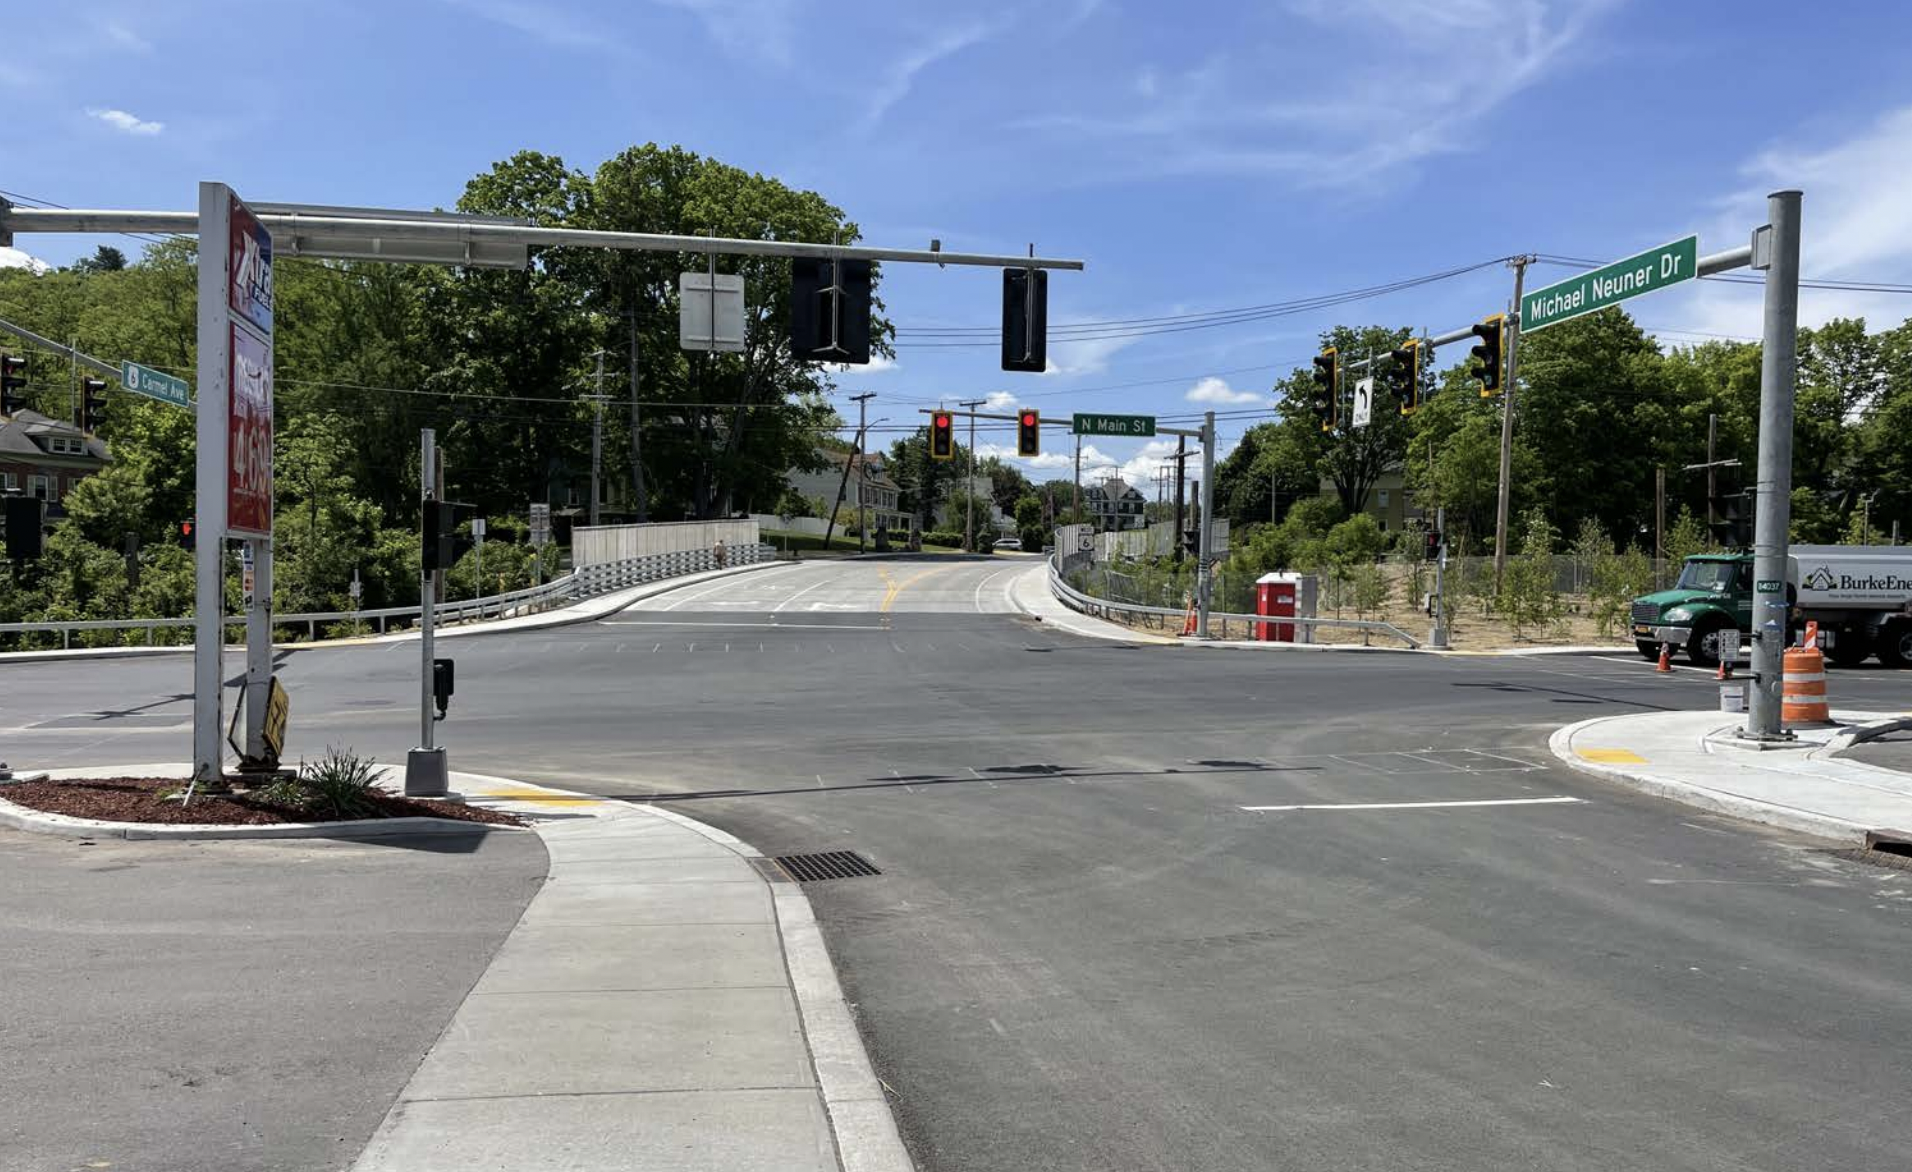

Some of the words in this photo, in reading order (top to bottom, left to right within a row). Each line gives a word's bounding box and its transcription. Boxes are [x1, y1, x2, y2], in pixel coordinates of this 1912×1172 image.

[1531, 283, 1585, 321] Michael
[1592, 265, 1653, 302] Neuner
[1660, 253, 1682, 279] Dr
[142, 373, 167, 396] Carmel
[171, 383, 185, 400] Ave
[1082, 418, 1091, 431] N
[1097, 418, 1127, 432] Main
[1133, 420, 1146, 433] St
[1082, 537, 1090, 548] 6
